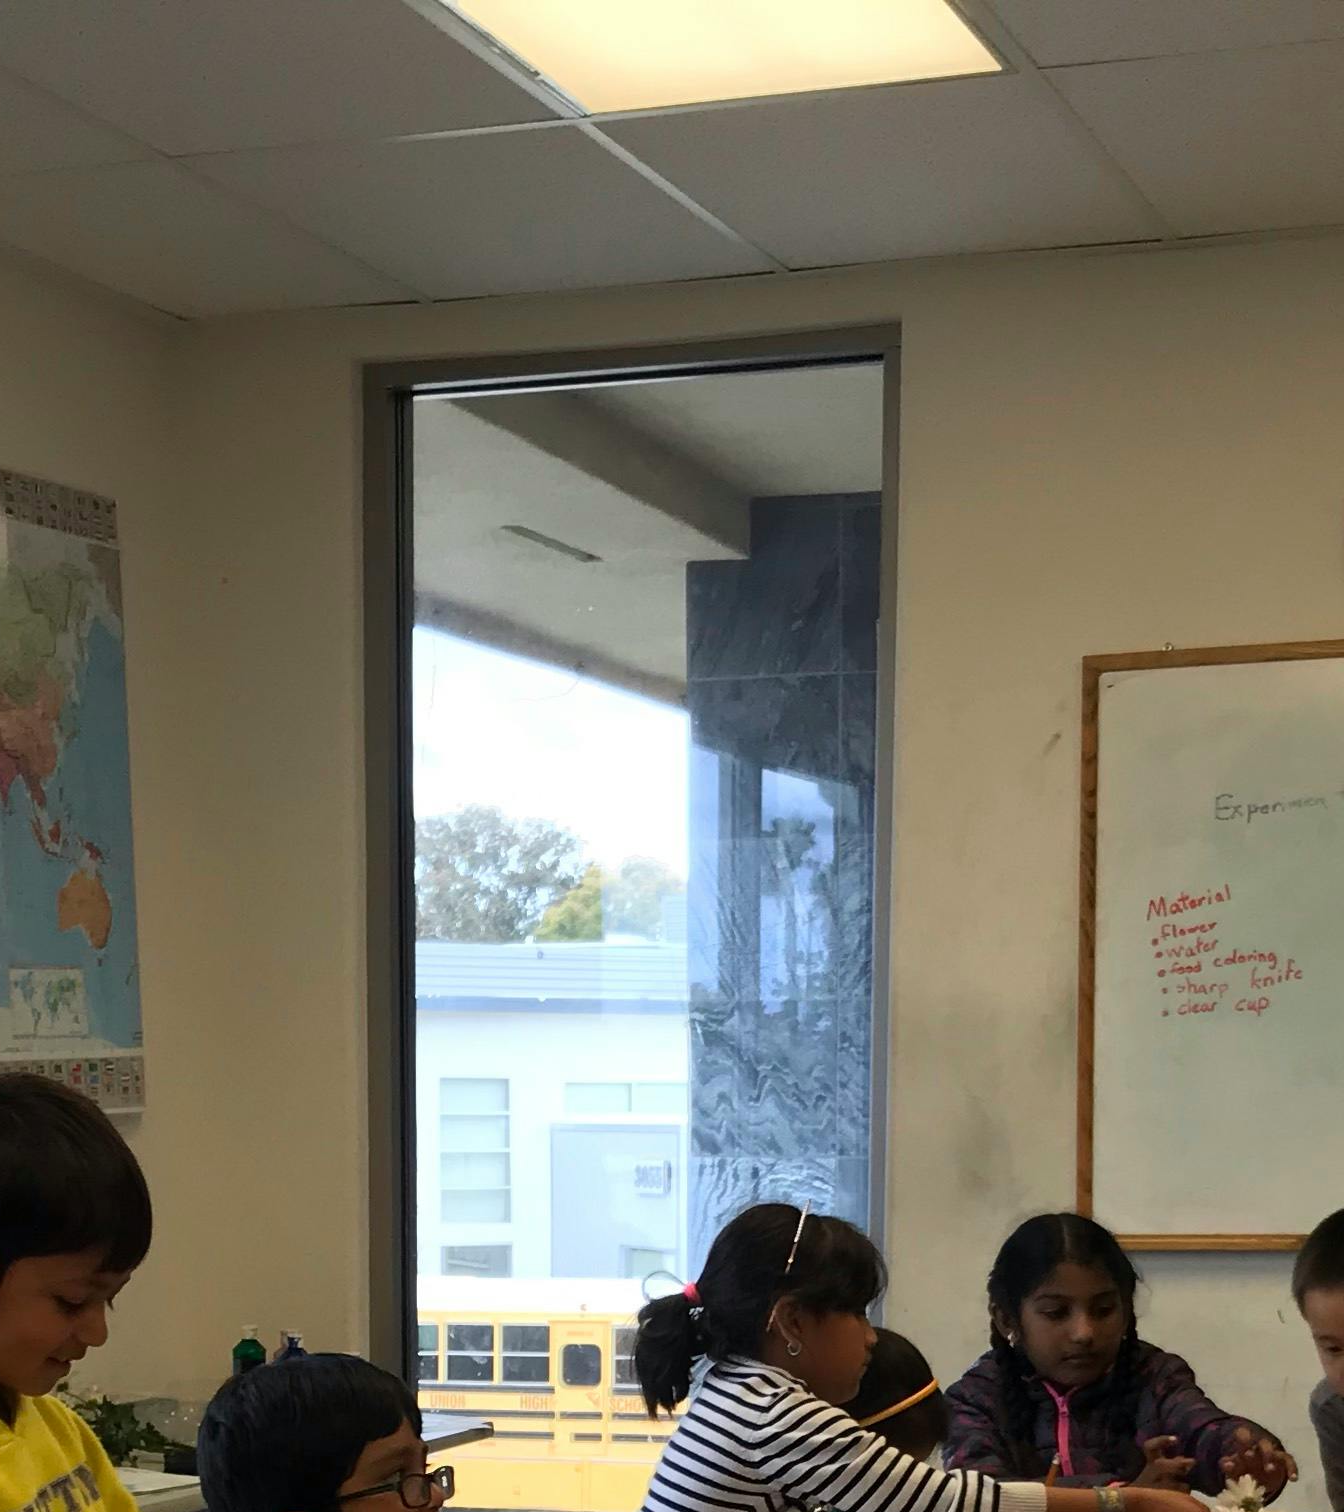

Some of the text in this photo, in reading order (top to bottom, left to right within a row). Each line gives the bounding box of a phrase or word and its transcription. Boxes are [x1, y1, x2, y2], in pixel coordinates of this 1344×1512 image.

[1146, 884, 1231, 921] Material
[1166, 936, 1219, 957] water
[1170, 949, 1277, 974] food coloring
[1176, 958, 1303, 998] sharp knife
[1177, 996, 1270, 1016] clear cup
[430, 1394, 644, 1412] UNION HIGH SCHO
